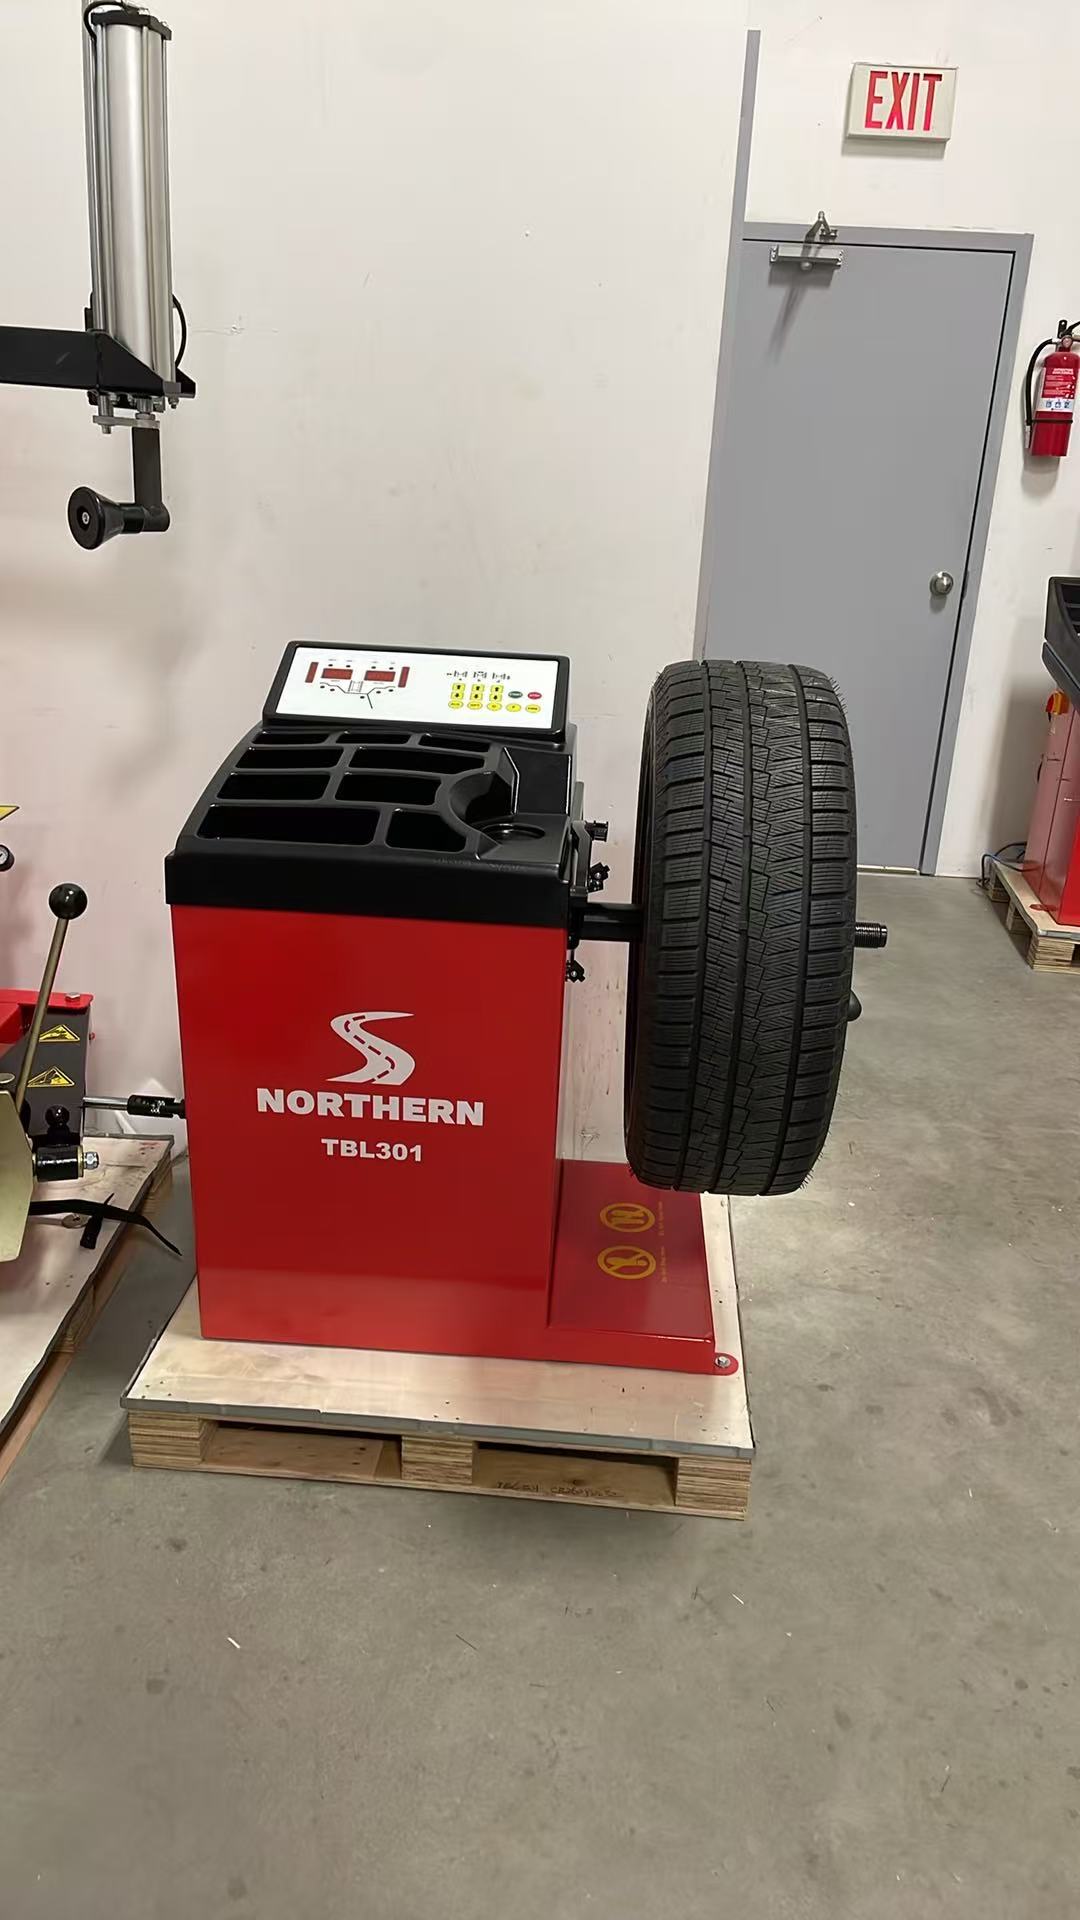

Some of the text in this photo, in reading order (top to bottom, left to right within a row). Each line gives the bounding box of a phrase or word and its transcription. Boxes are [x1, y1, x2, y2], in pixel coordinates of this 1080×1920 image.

[865, 70, 943, 131] EXIT
[256, 1087, 484, 1127] NORTHERN
[320, 1138, 422, 1162] TBL301
